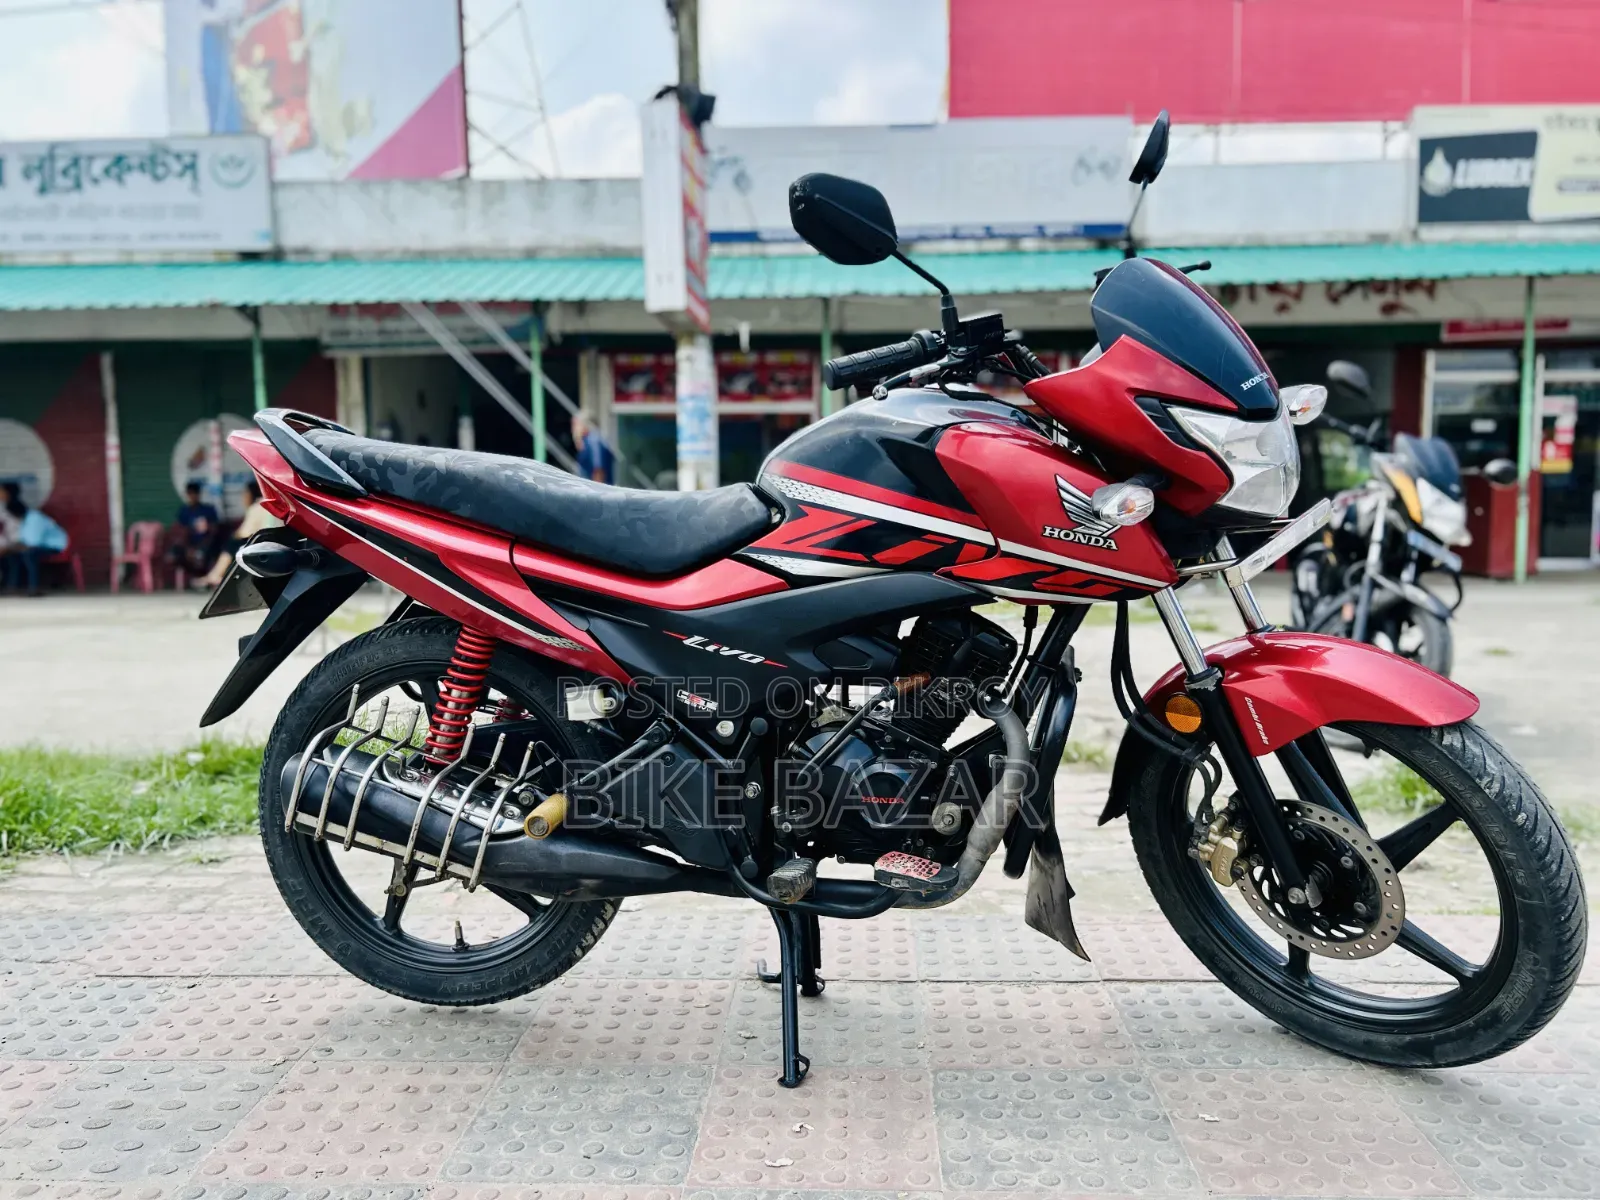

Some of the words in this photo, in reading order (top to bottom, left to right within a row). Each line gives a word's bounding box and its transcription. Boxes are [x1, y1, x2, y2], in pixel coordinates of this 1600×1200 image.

[1240, 371, 1270, 391] HONDA
[1042, 525, 1119, 551] HONDA
[682, 634, 766, 665] Livo
[860, 795, 906, 805] HONDA
[1499, 966, 1537, 1023] MRF
